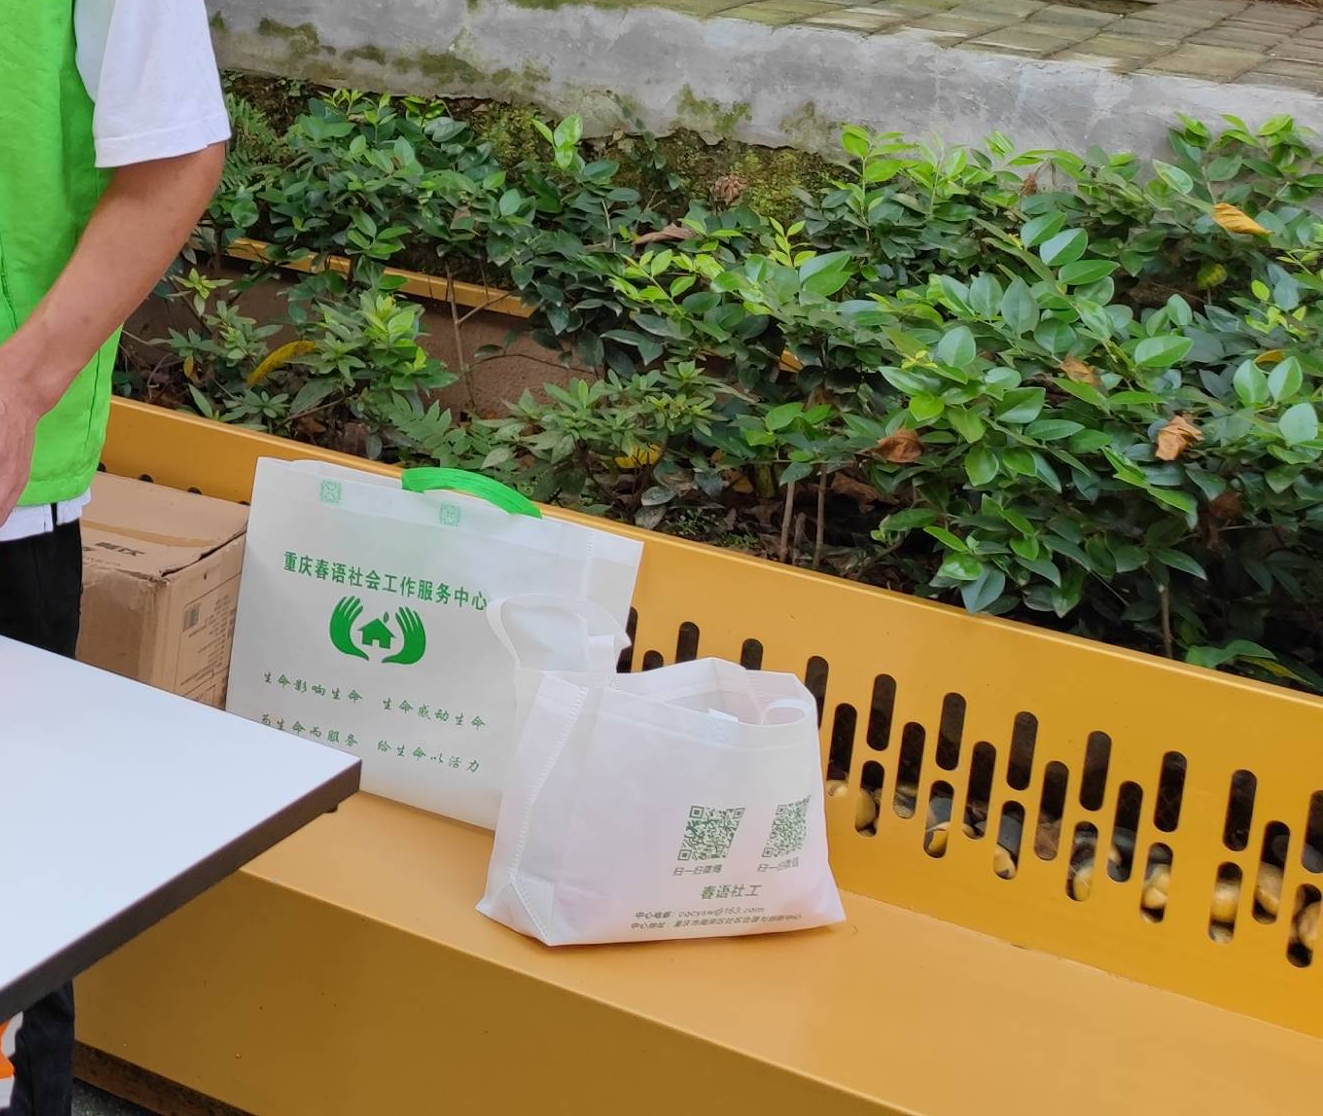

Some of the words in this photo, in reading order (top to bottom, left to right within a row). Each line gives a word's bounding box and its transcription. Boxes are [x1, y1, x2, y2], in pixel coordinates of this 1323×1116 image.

[283, 550, 488, 613] 重庆春语社会工作服务中心
[263, 670, 364, 703] 生命影响生命
[382, 696, 487, 729] 生命感动生命
[259, 713, 360, 748] 为生命而服务
[376, 739, 480, 774] 给生命以活力
[701, 884, 763, 900] 春语社工
